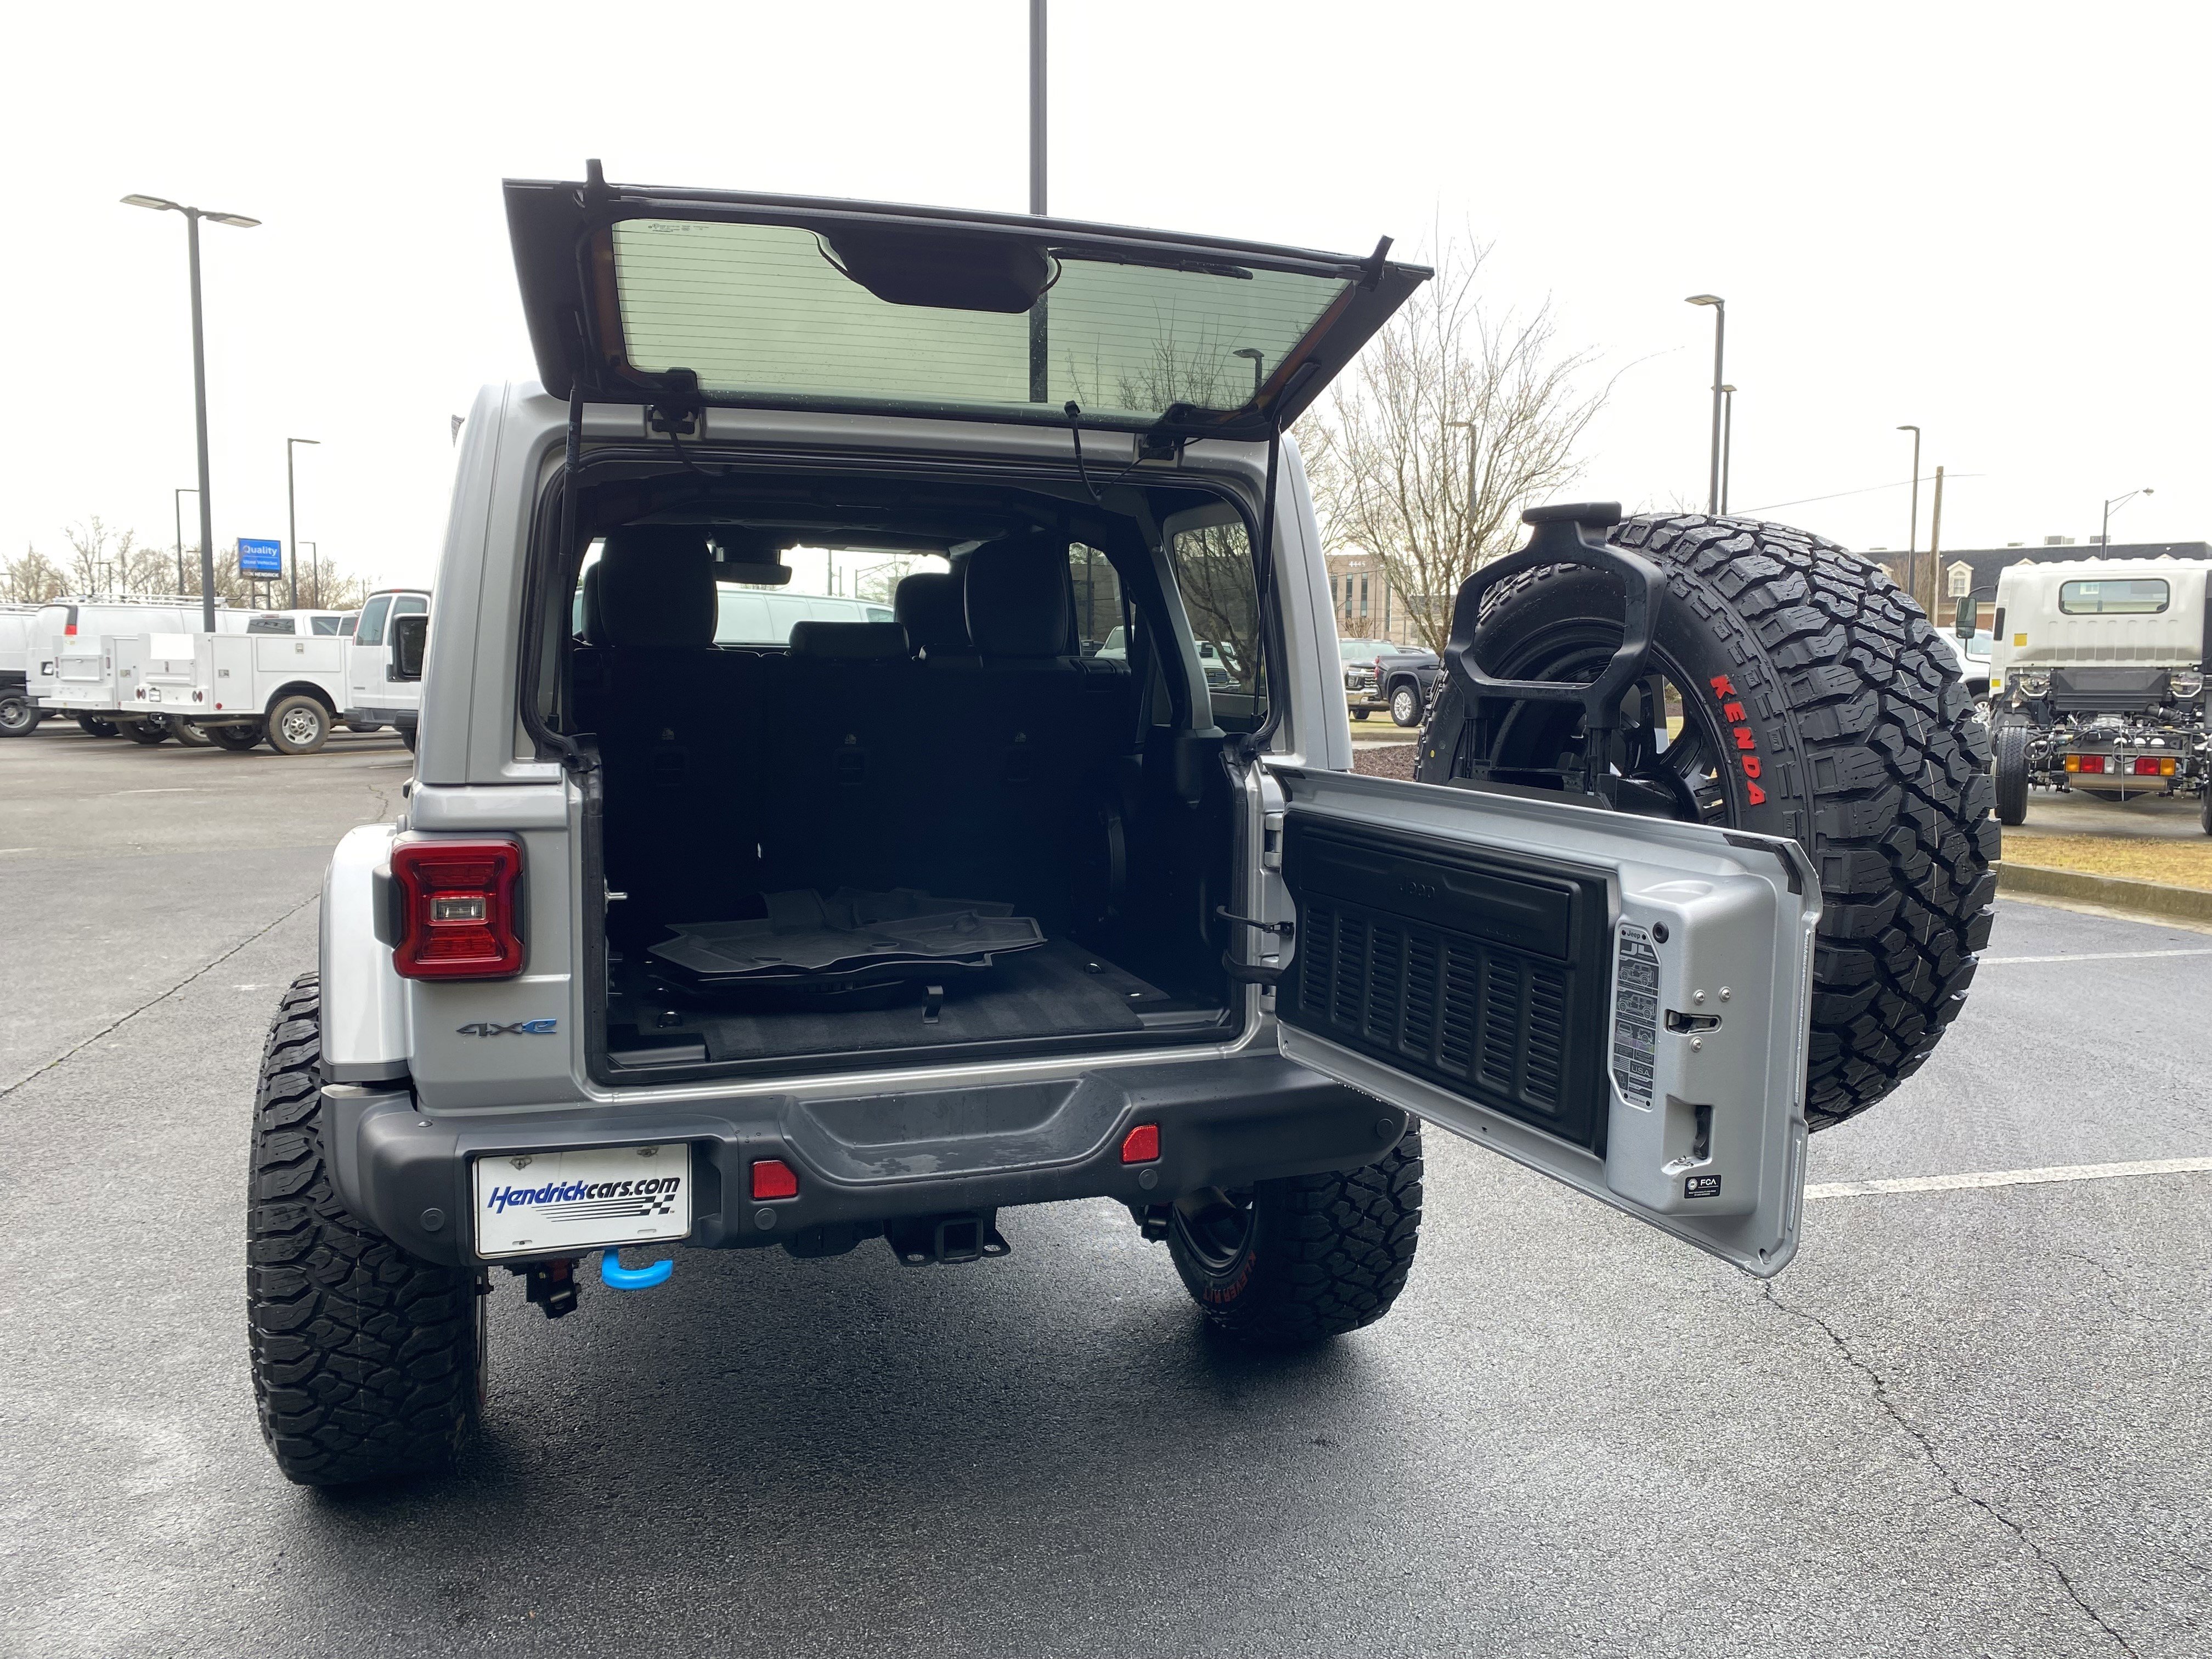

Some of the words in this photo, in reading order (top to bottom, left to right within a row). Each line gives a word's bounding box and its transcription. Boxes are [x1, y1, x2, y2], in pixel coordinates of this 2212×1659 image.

[242, 545, 278, 556] Quality
[1710, 674, 1766, 805] KENDA
[1627, 930, 1640, 940] Jeep
[1620, 943, 1655, 957] JL
[487, 1177, 681, 1214] Hendrickcars.com
